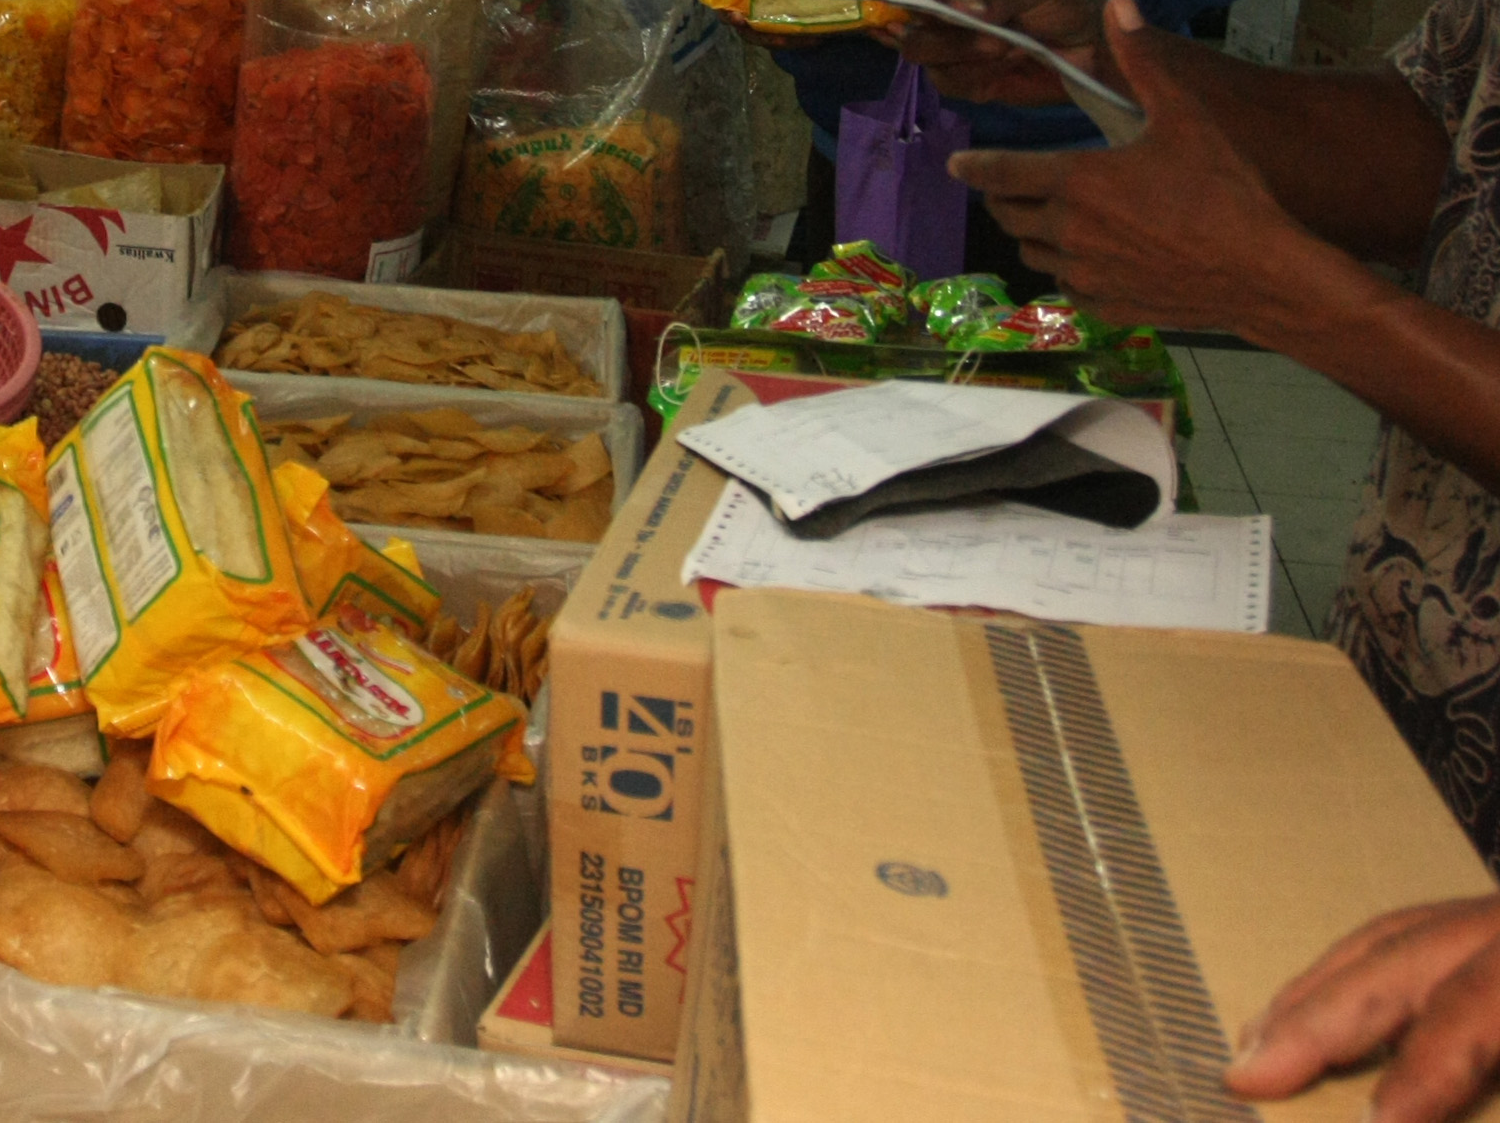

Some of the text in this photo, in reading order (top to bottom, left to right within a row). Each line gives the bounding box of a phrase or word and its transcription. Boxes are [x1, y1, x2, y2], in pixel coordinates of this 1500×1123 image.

[118, 245, 176, 264] Kwalitas
[599, 689, 676, 822] 40
[676, 700, 694, 754] ISI
[580, 745, 599, 812] BKS
[616, 866, 644, 1019] BPOM RI MD
